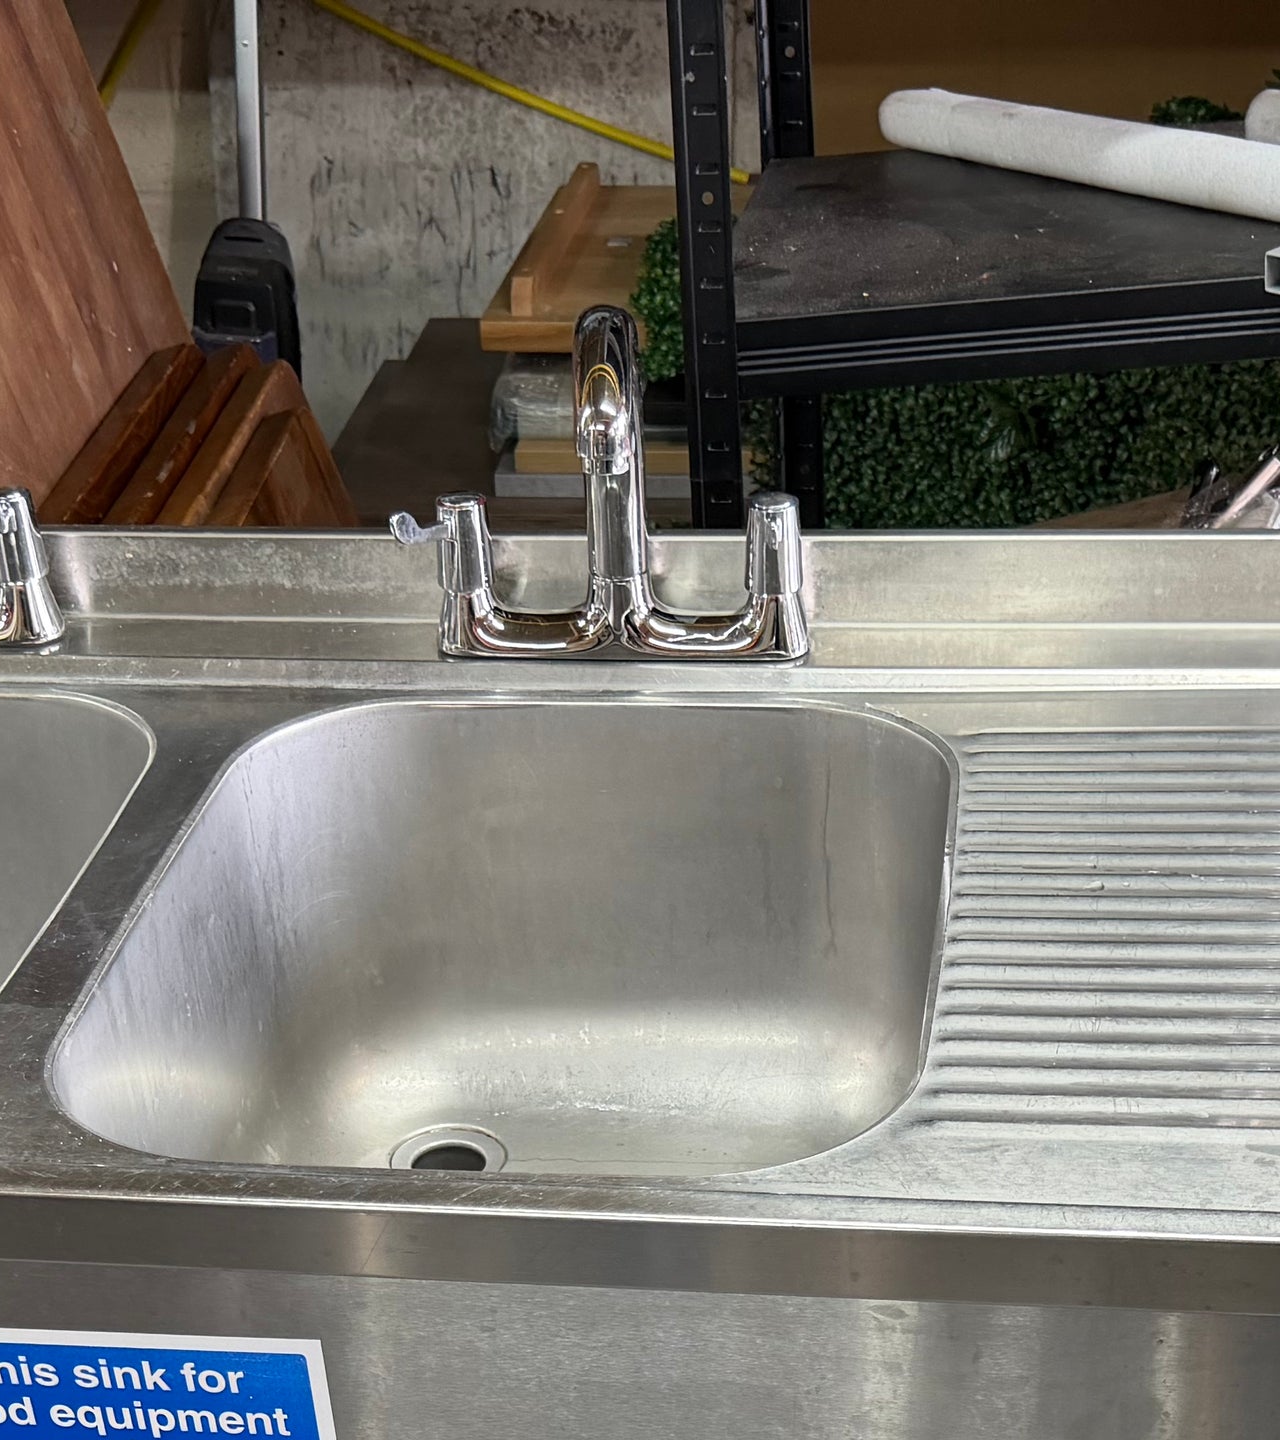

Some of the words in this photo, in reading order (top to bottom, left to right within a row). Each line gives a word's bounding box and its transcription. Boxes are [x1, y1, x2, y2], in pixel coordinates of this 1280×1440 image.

[72, 1358, 172, 1391] sink
[179, 1362, 244, 1394] for
[49, 1400, 291, 1439] equipment
